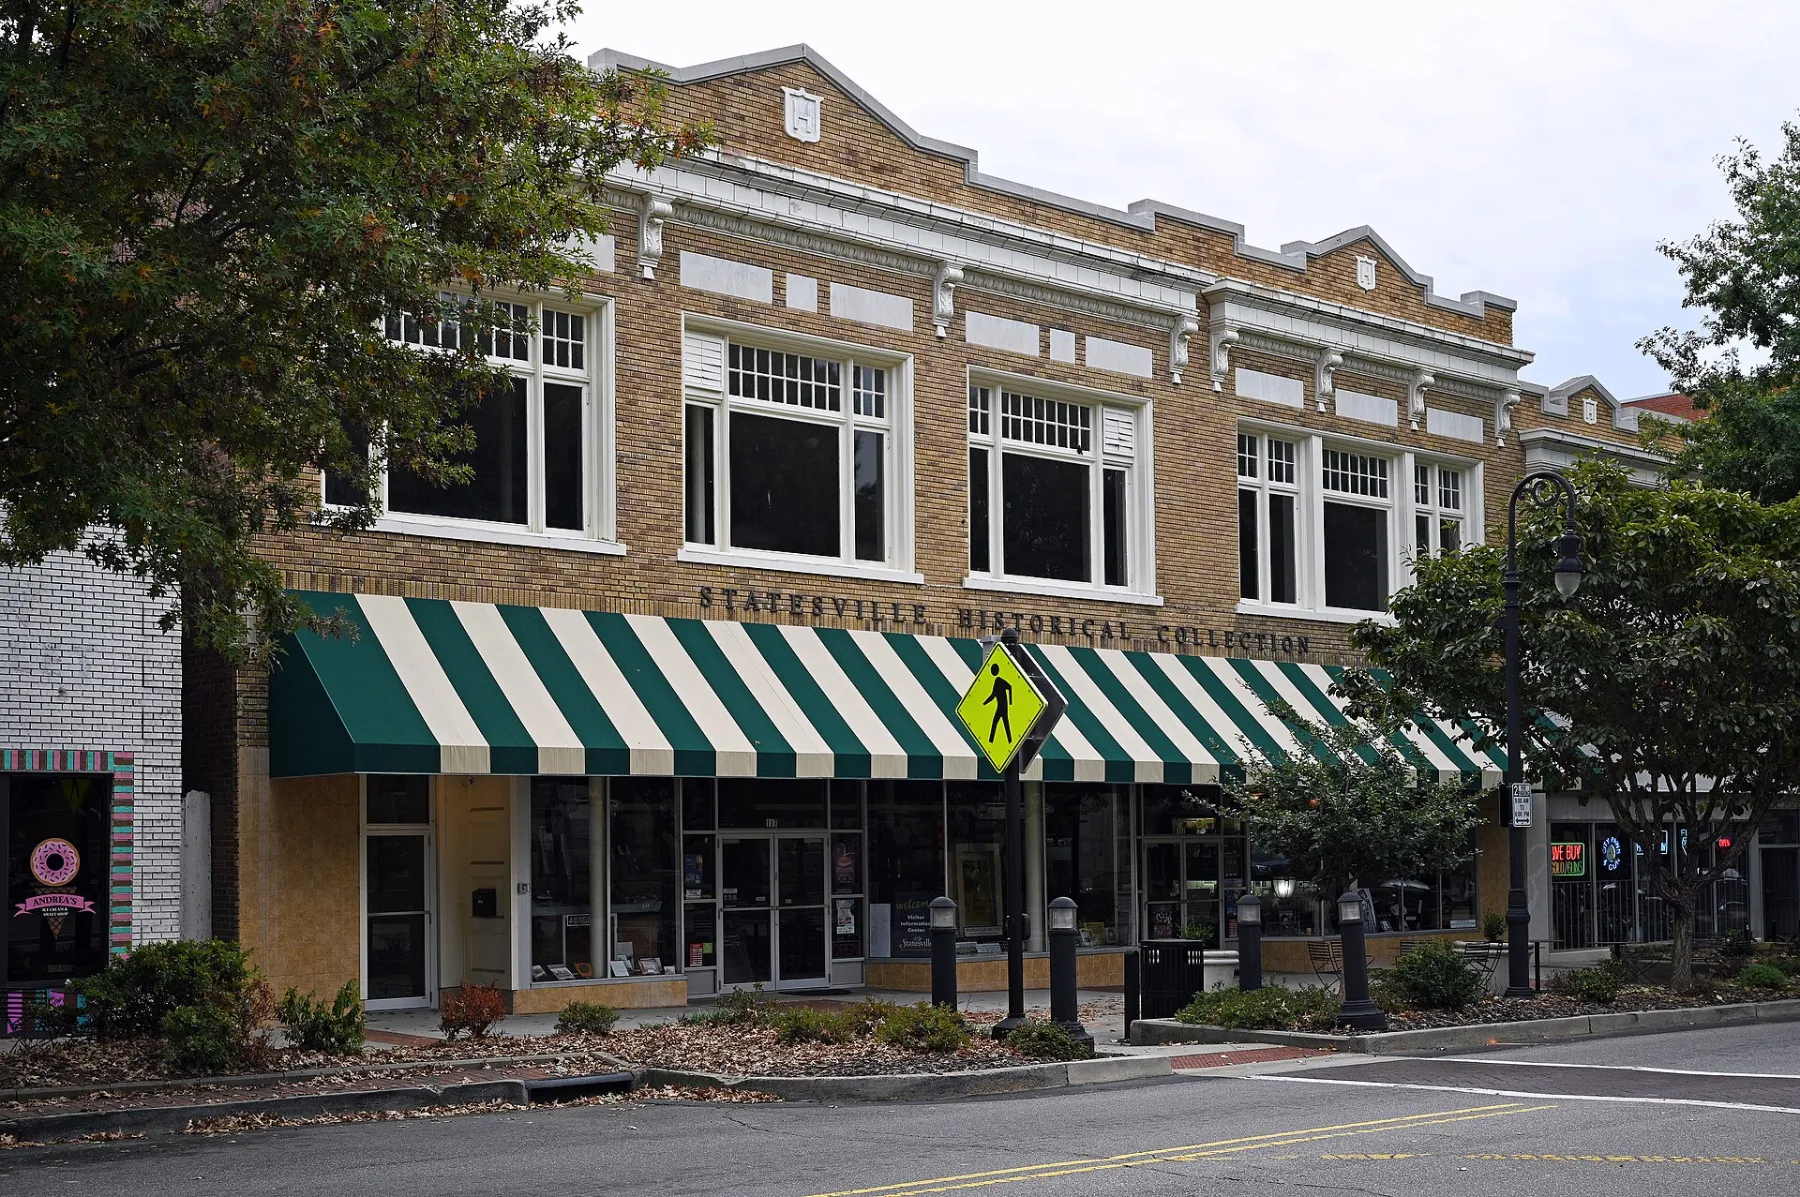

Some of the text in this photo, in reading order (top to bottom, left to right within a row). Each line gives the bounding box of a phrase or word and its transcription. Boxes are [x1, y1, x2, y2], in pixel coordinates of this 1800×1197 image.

[700, 585, 1309, 653] STATESVILLE HISTORICAL COLLECTION
[1513, 785, 1519, 796] 2
[1719, 838, 1731, 847] OPEN
[1565, 845, 1581, 860] BUY
[33, 896, 77, 907] ANDREA'S
